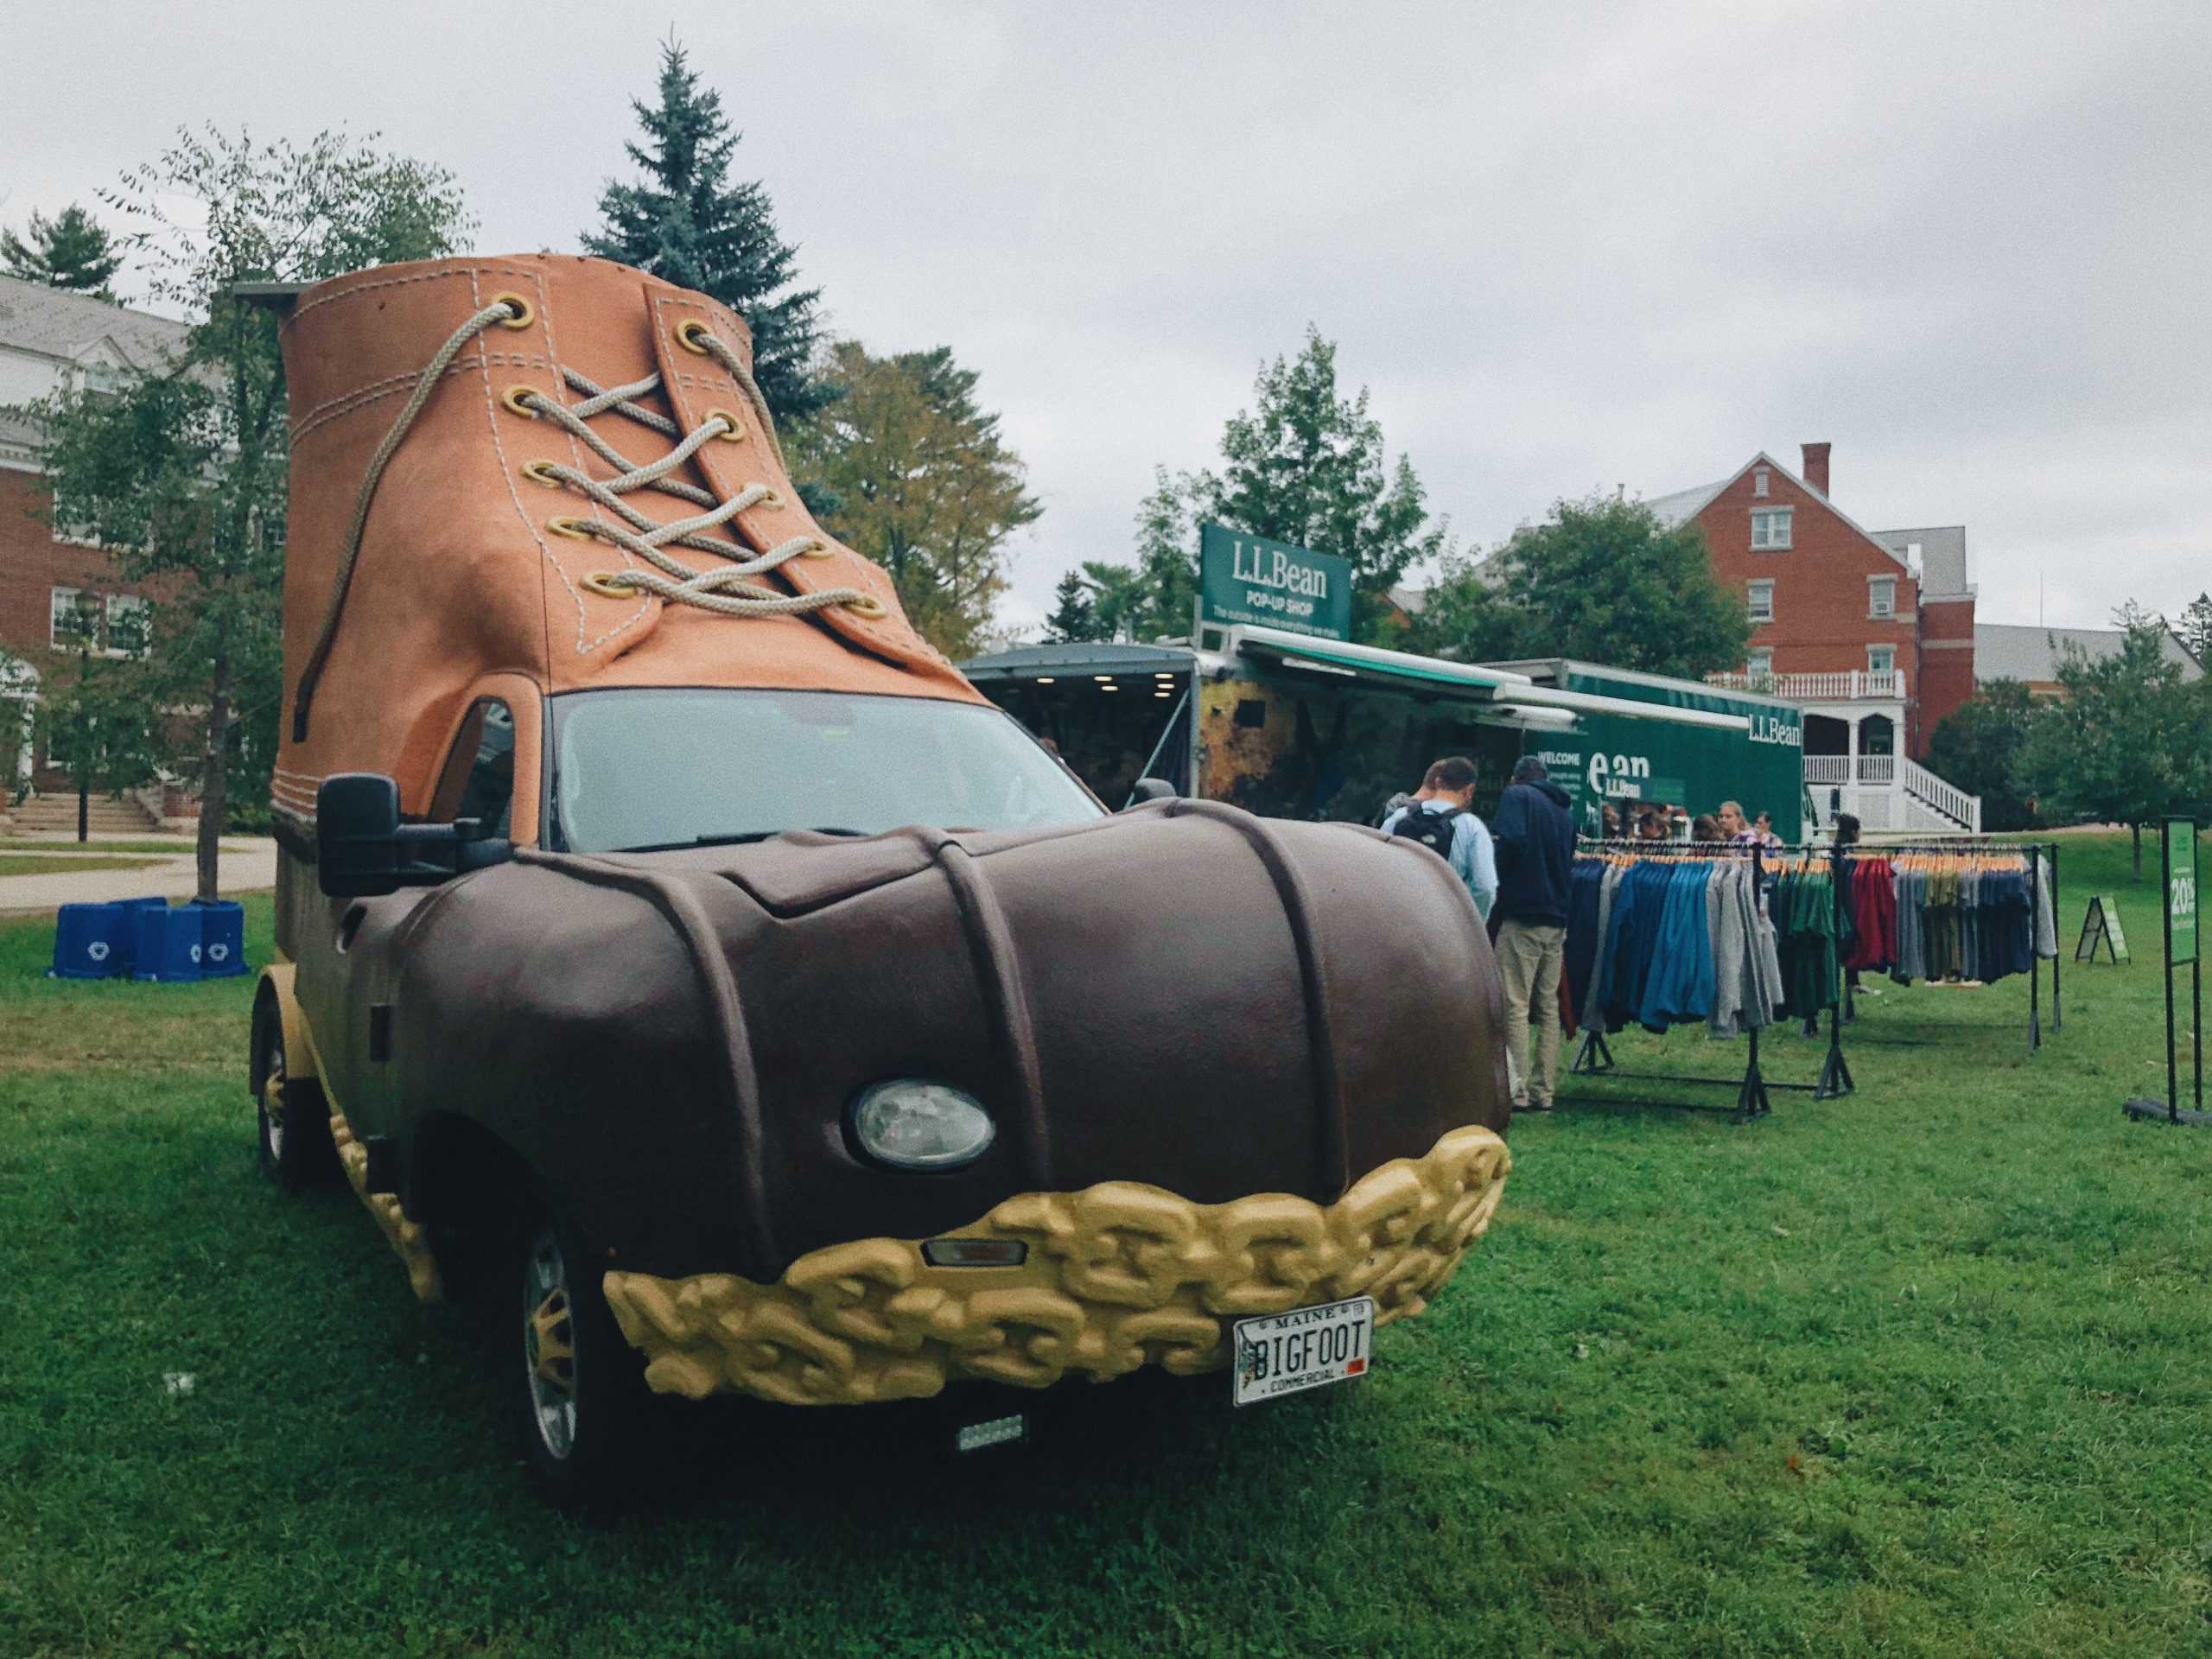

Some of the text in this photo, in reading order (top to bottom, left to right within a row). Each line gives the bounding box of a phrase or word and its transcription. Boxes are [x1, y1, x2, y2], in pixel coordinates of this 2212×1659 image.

[1233, 540, 1327, 599] L.L.Bean
[1246, 590, 1313, 616] POP-UP SHOP
[1537, 751, 1580, 766] WELCOME
[1274, 1307, 1336, 1329] MAINE
[1254, 1319, 1365, 1381] BIGFOOT
[1270, 1369, 1334, 1392] COMMERCIAL
